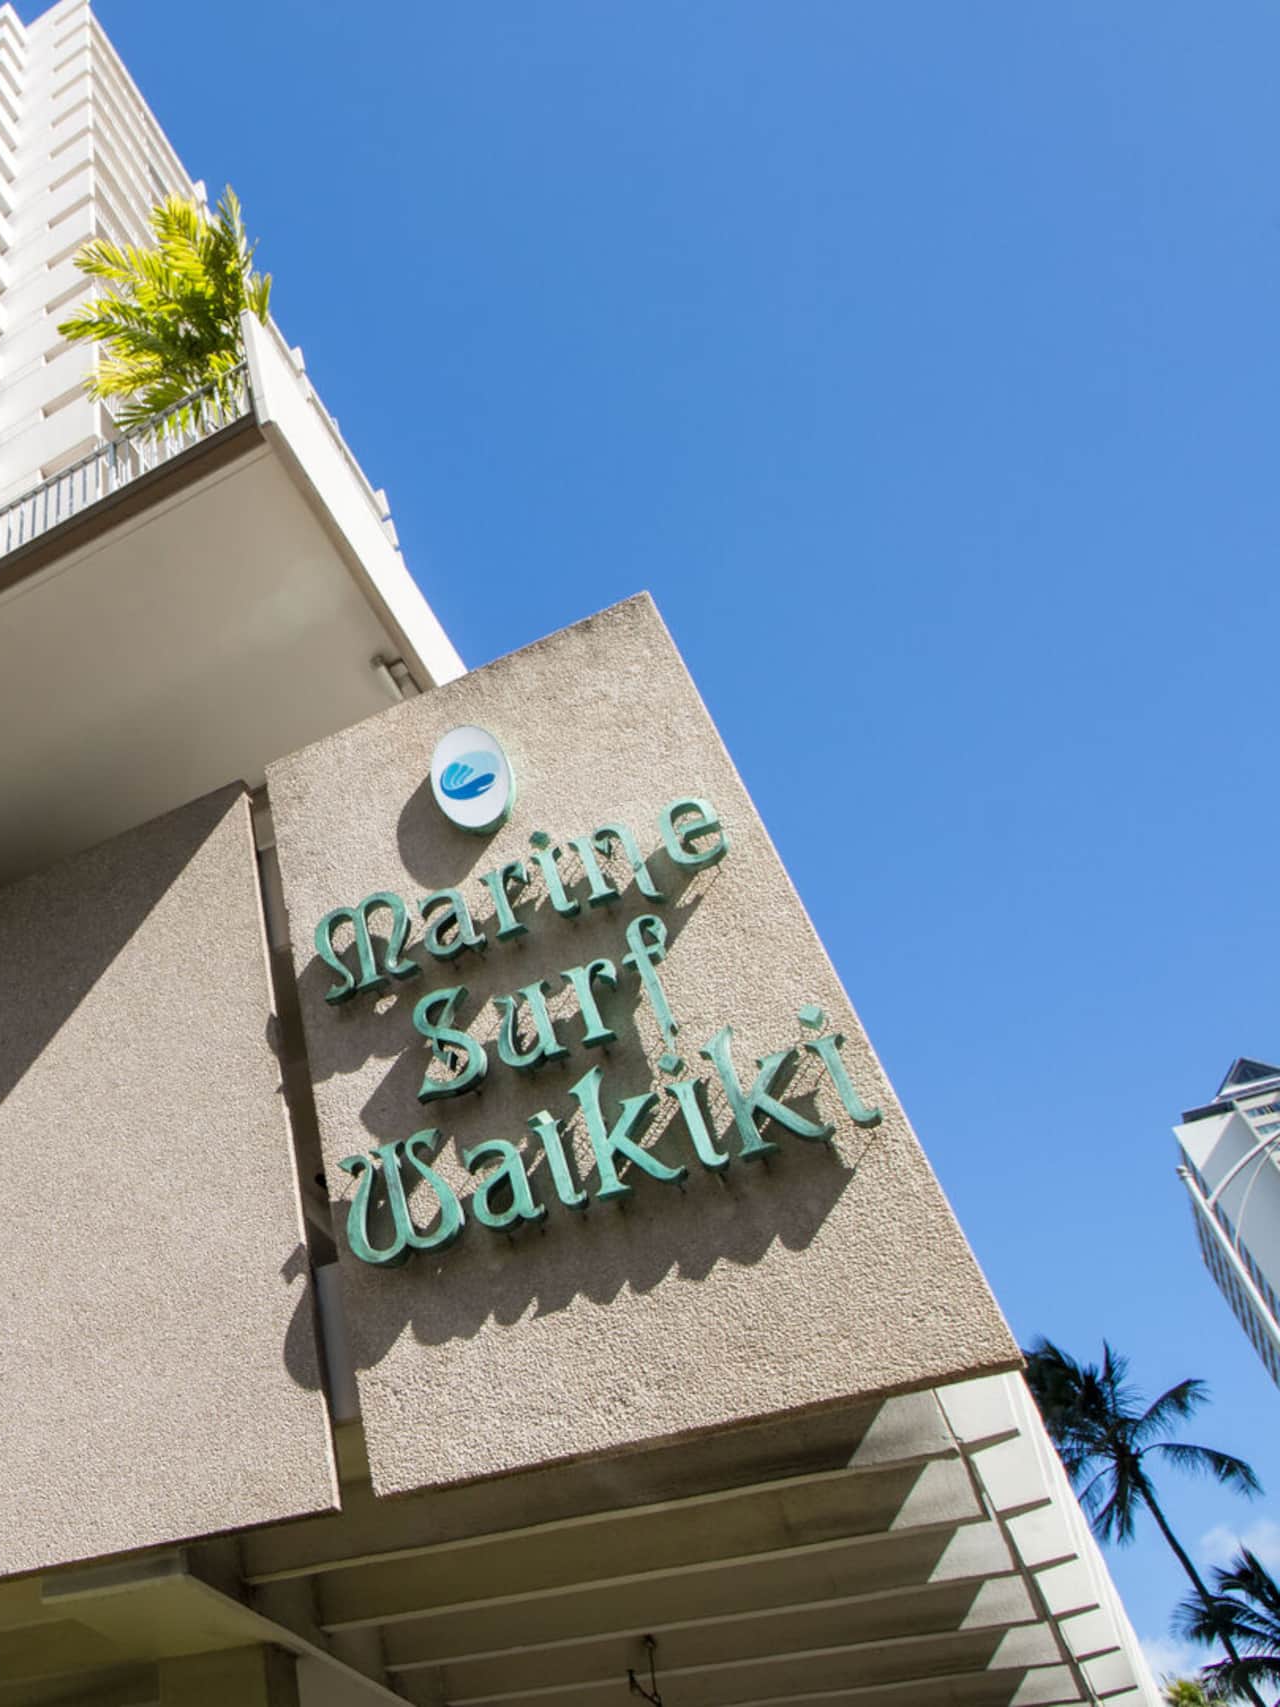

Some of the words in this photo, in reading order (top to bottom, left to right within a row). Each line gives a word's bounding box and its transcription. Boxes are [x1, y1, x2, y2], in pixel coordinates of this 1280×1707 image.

[314, 797, 730, 1005] Marine
[412, 914, 679, 1104] Surf
[338, 1003, 884, 1268] Waikiki
